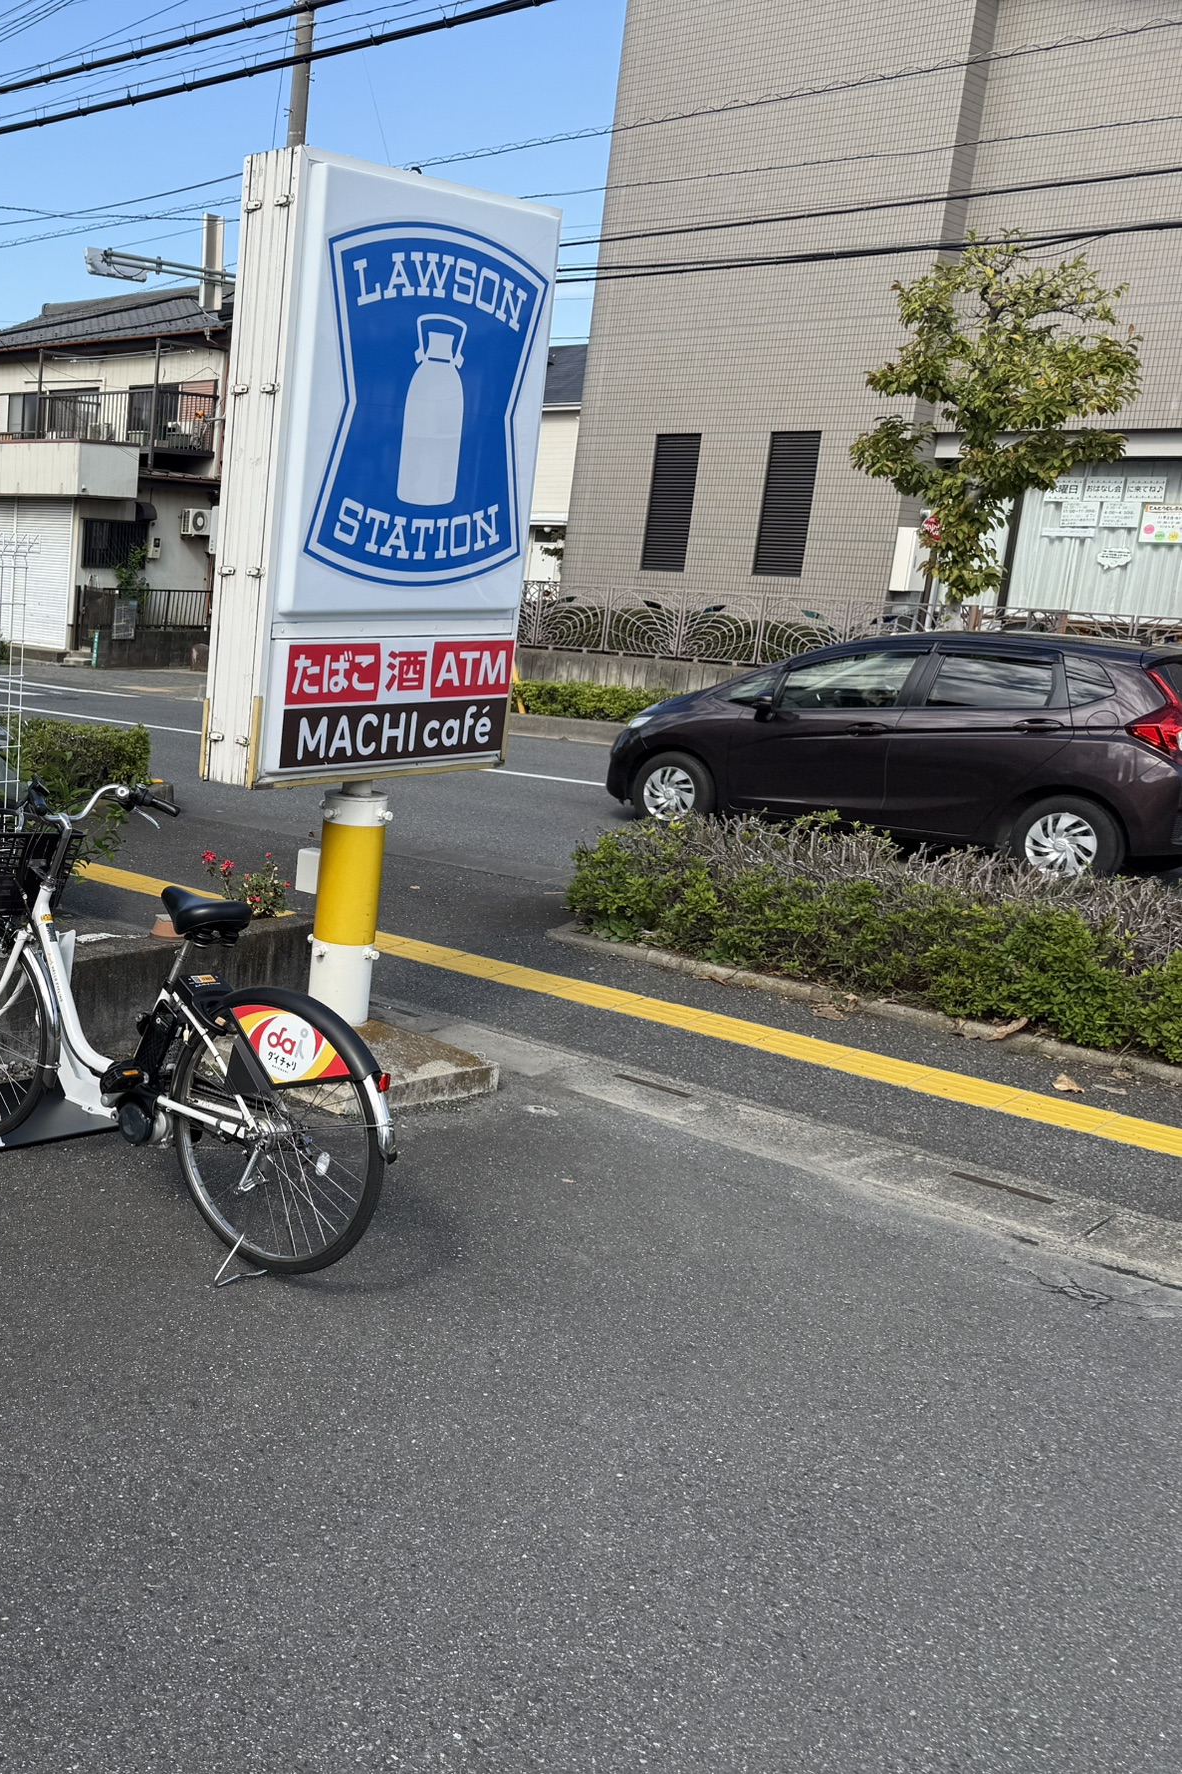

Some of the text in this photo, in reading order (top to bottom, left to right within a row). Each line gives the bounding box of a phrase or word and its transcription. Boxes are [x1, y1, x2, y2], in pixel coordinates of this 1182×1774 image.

[353, 250, 528, 333] LAWSON
[1086, 484, 1122, 493] おはなし会
[333, 496, 500, 560] STATION
[291, 650, 375, 696] たばこ
[384, 650, 425, 692] 酒
[434, 649, 507, 688] ATM
[297, 705, 492, 761] MACHI café
[267, 1027, 309, 1060] dai
[268, 1051, 297, 1071] ダイチャリ
